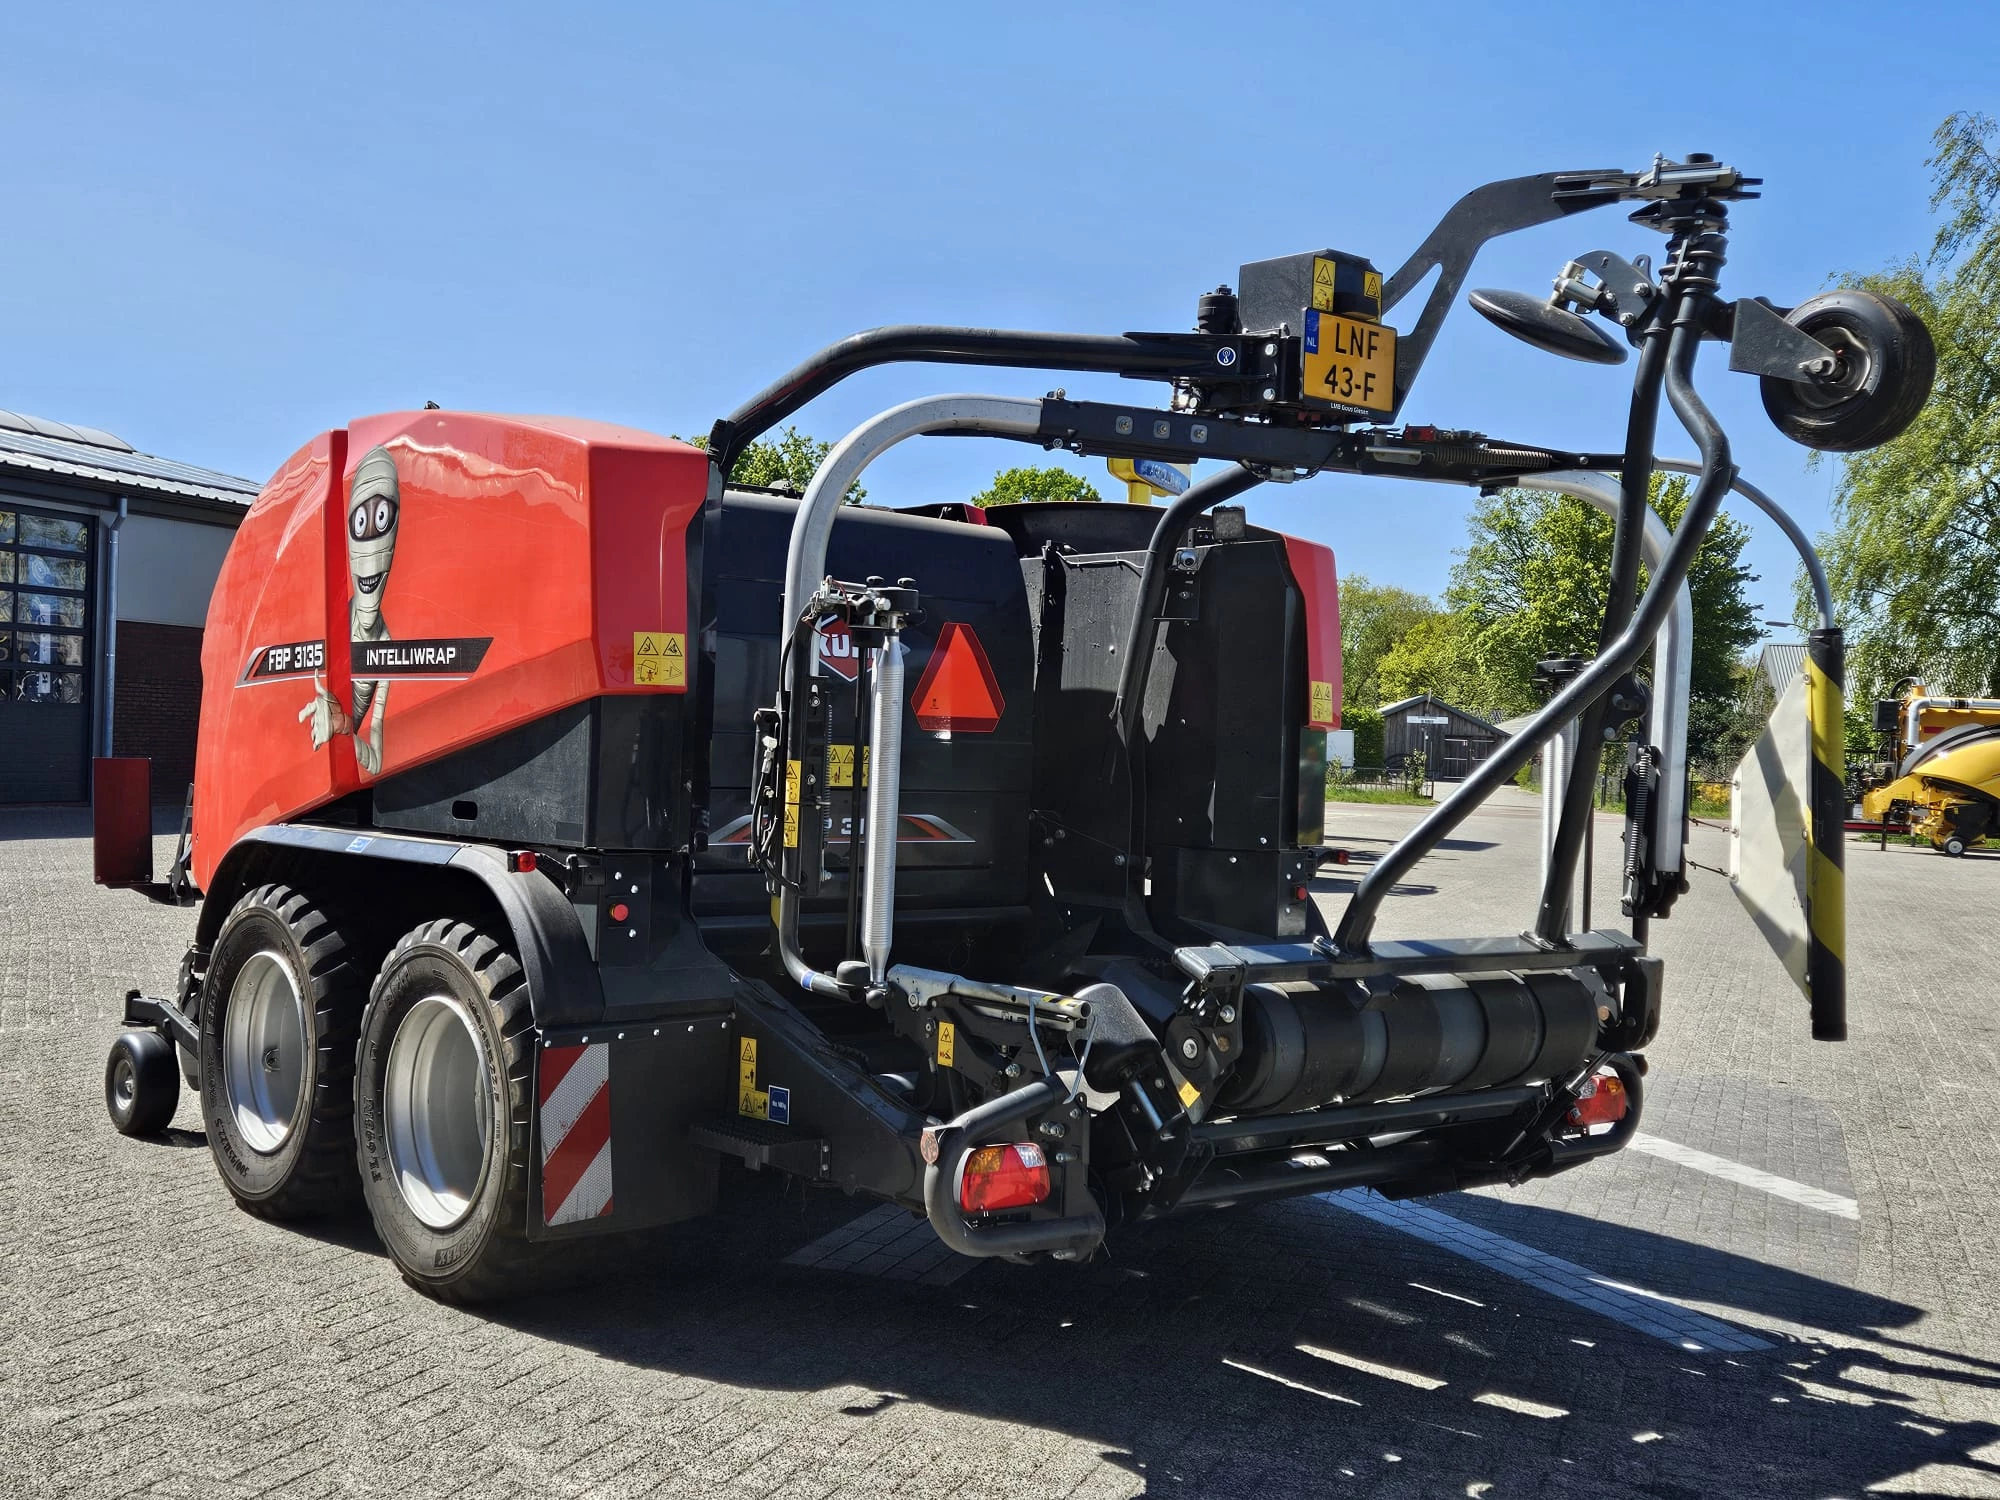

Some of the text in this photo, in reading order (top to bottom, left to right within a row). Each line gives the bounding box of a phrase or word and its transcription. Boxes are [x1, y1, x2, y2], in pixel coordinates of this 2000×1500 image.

[1306, 336, 1318, 347] NL
[1335, 322, 1380, 360] LNF
[1324, 364, 1377, 402] 43-F
[268, 644, 324, 672] FBP 3135
[366, 647, 456, 666] INTELLIWRAP
